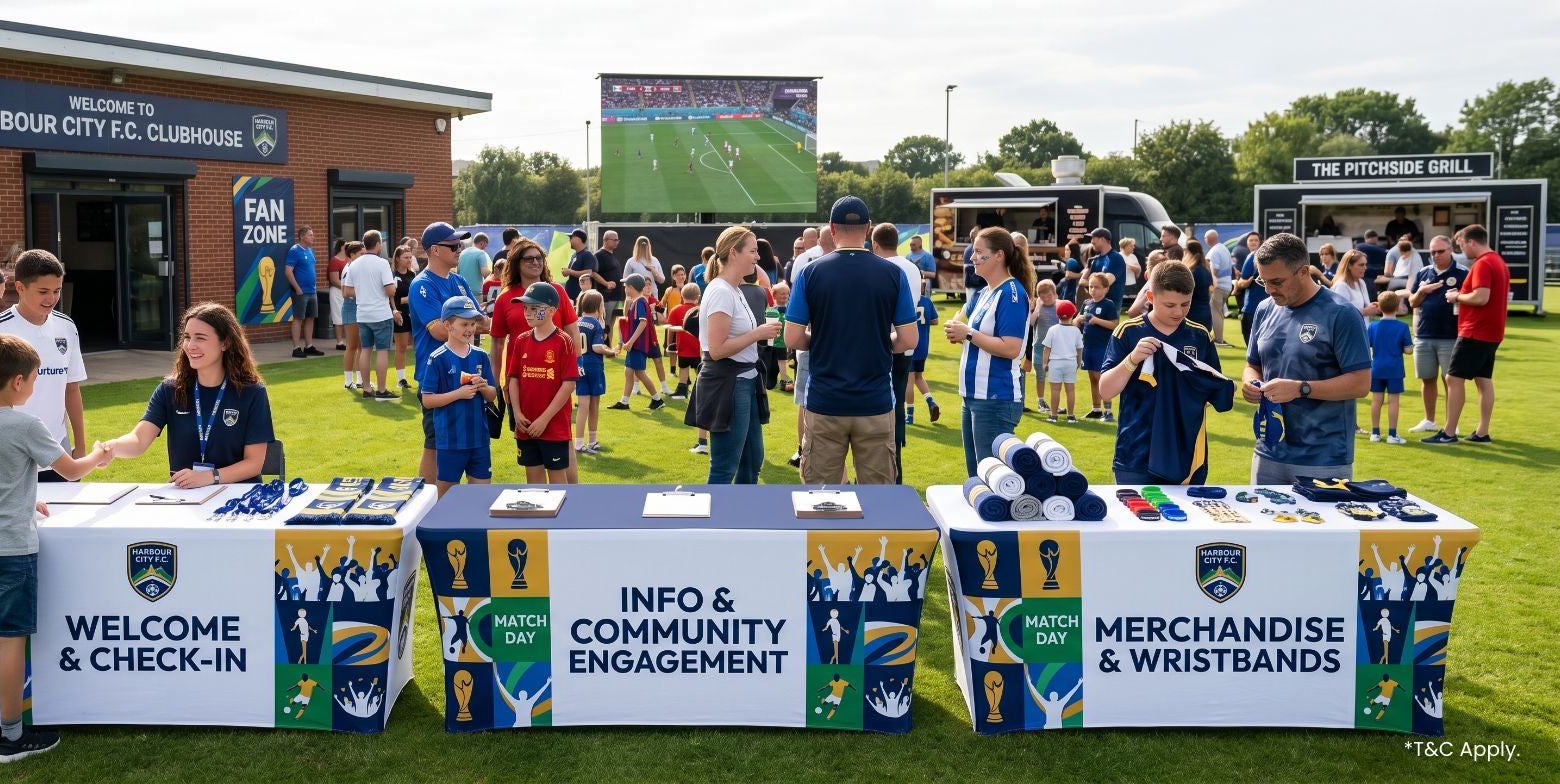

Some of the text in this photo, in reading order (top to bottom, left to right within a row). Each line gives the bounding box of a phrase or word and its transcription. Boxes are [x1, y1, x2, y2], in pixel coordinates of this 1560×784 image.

[68, 95, 155, 116] WELCOME TO
[62, 116, 107, 138] CITY
[111, 120, 142, 141] F.C.
[147, 123, 243, 147] CLUBHOUSE
[1311, 158, 1474, 177] THE PITCHSIDE GRILL
[244, 198, 285, 222] FAN
[242, 225, 288, 244] ZONE
[132, 548, 172, 556] HARBOUR
[1201, 549, 1241, 557] HARBOUR
[621, 586, 736, 613] INFO &
[65, 615, 241, 641] WELCOME
[494, 614, 547, 628] MATCH
[570, 618, 787, 645] COMMUNITY
[1025, 615, 1079, 628] MATCH
[1095, 616, 1345, 643] MERCHANDISE
[505, 631, 536, 645] DAY
[1036, 632, 1068, 645] DAY
[58, 646, 247, 672] & CHECK-IN
[569, 649, 789, 674] ENGAGEMENT
[1098, 647, 1341, 674] & WRISTBANDS
